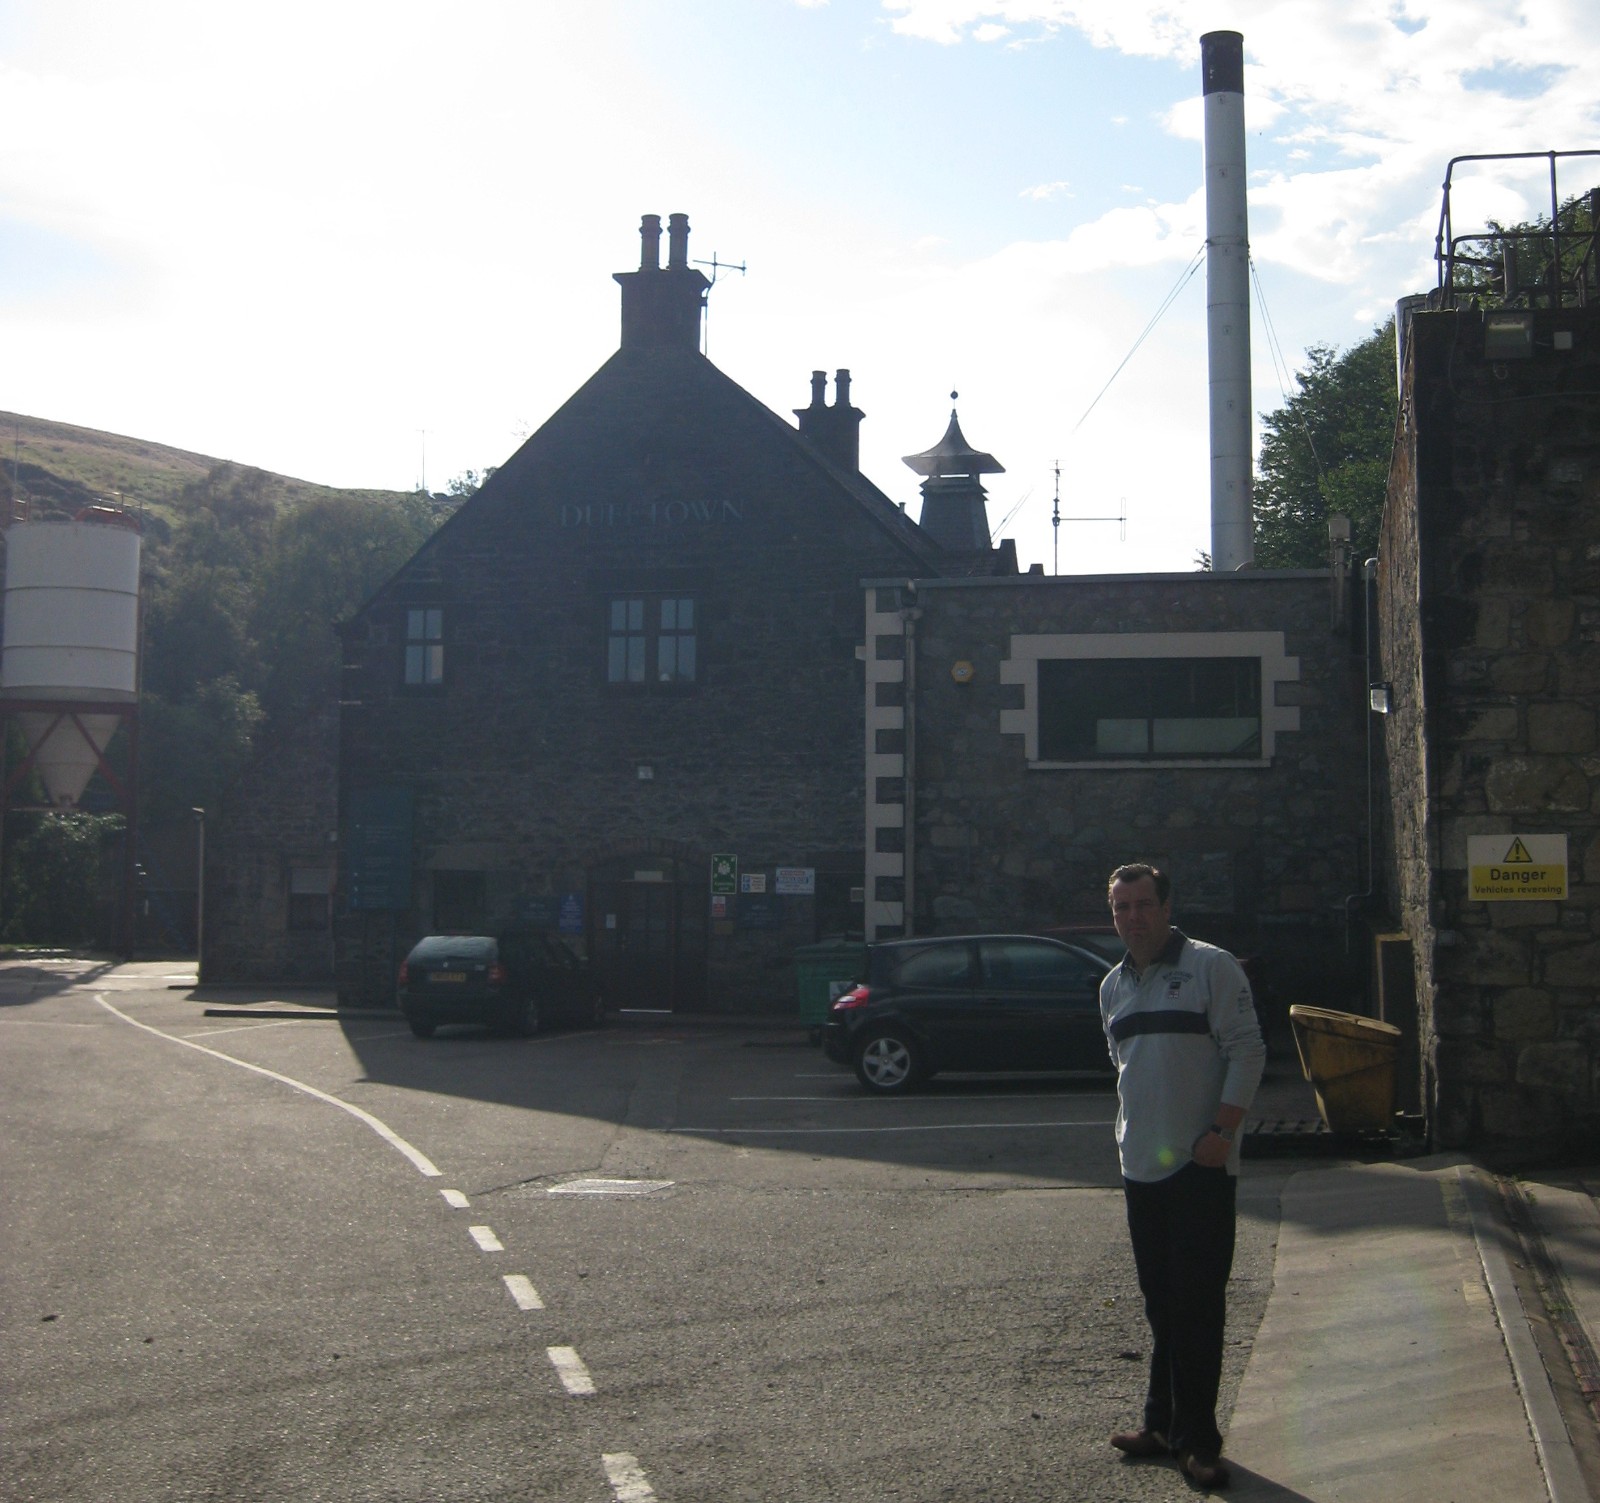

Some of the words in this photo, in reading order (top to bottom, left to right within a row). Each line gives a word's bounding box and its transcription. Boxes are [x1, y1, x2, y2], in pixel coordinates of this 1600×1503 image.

[1490, 868, 1547, 883] Danger
[1474, 885, 1514, 894] Vehicles
[1517, 885, 1562, 895] reversing
